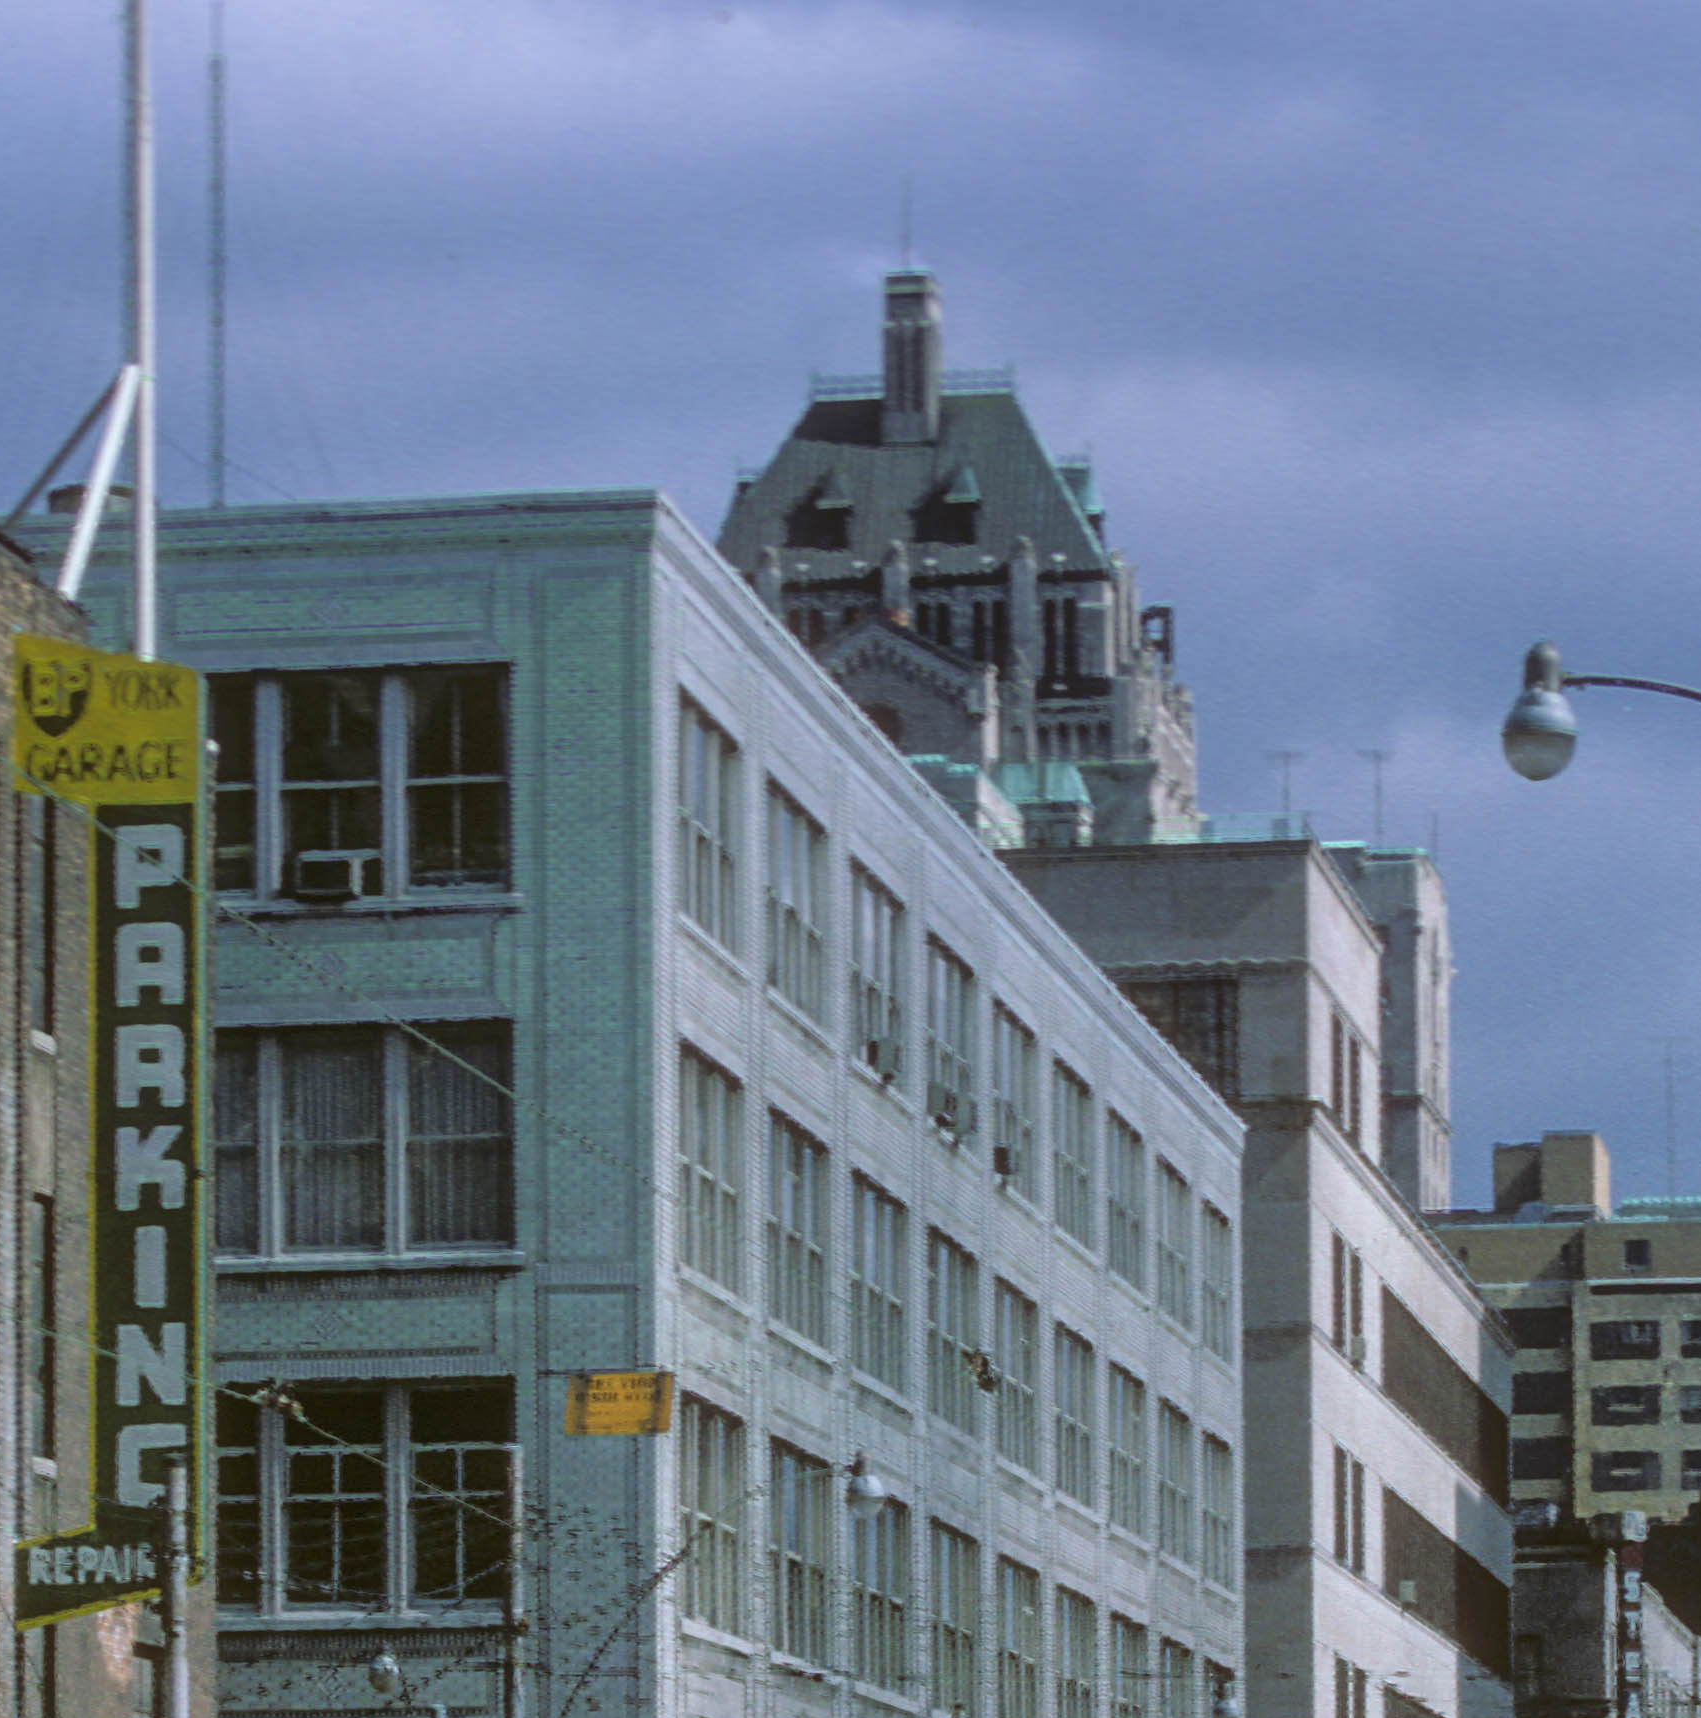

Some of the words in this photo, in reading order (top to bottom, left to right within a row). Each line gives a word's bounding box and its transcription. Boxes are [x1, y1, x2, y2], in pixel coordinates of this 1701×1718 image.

[105, 669, 181, 711] YORK
[27, 738, 187, 784] GARAGE
[114, 823, 187, 1509] PARKING
